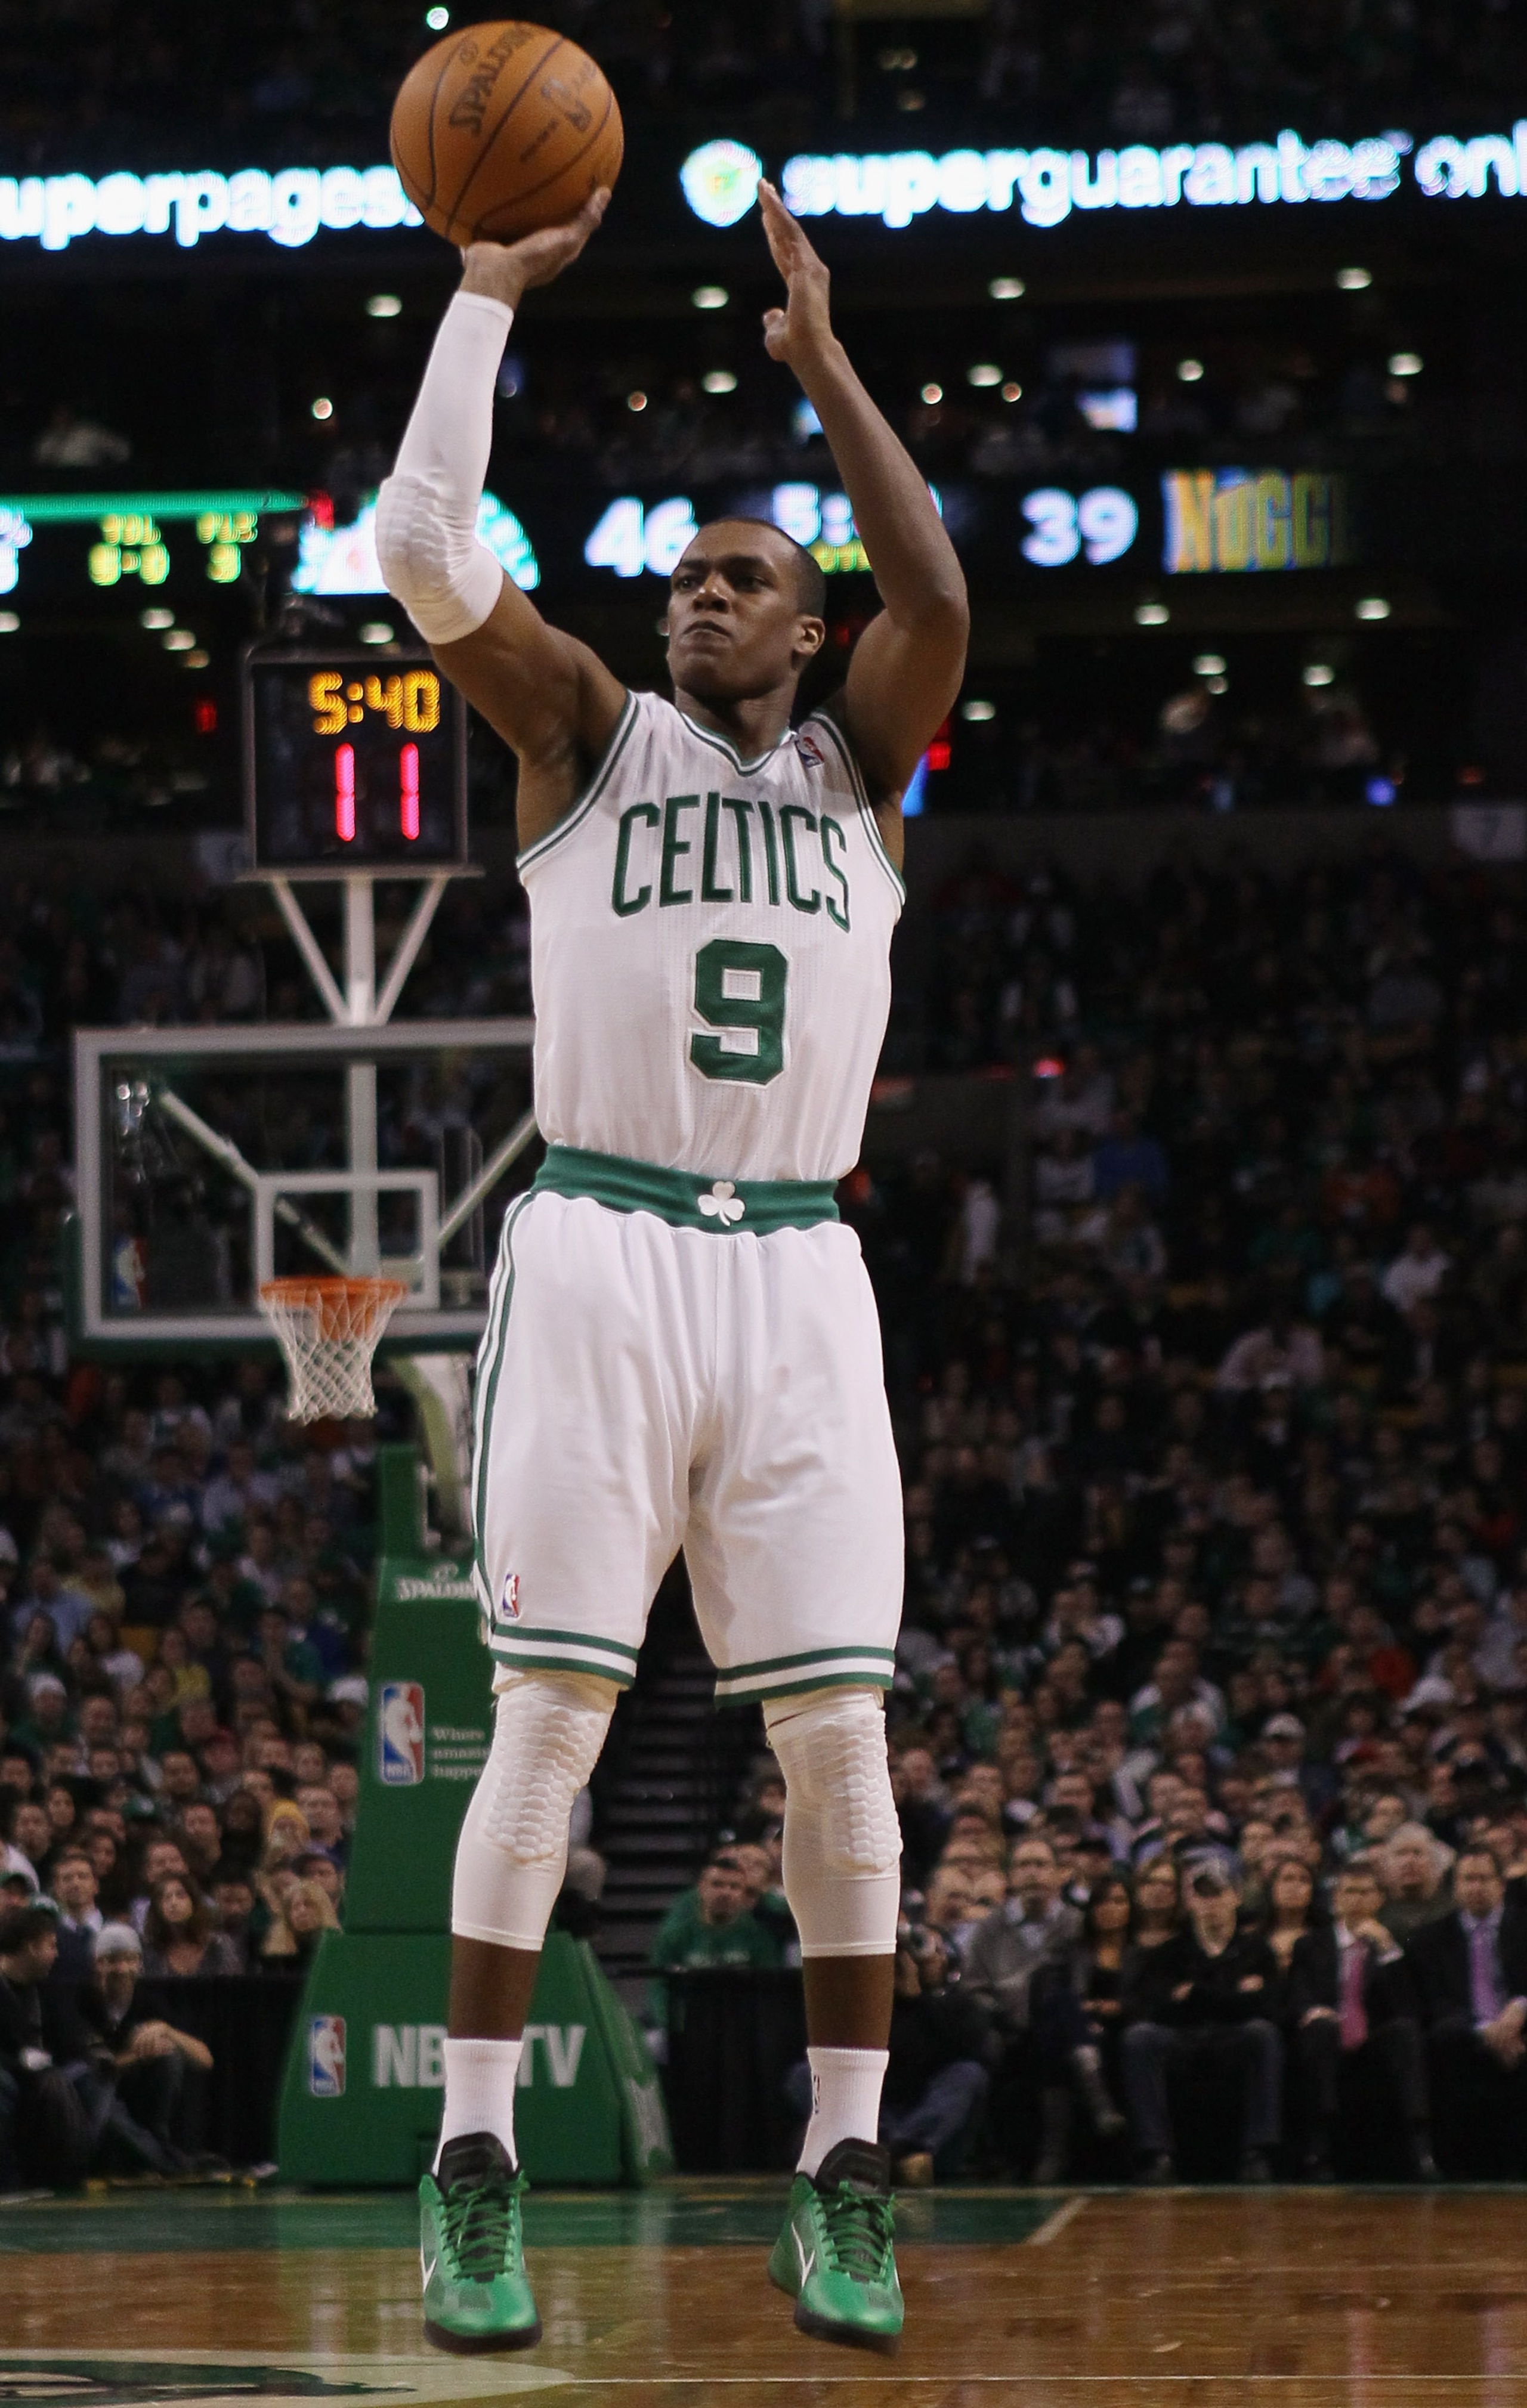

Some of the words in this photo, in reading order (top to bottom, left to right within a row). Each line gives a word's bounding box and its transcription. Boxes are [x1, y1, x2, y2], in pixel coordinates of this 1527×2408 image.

[782, 128, 1402, 228] superguarantee
[584, 494, 700, 578] 46
[1021, 487, 1139, 566] 39
[308, 669, 440, 735] 5:40
[335, 741, 420, 842] 11
[612, 791, 851, 933] CELTICS
[689, 938, 789, 1085] 9
[375, 2025, 449, 2087] NB
